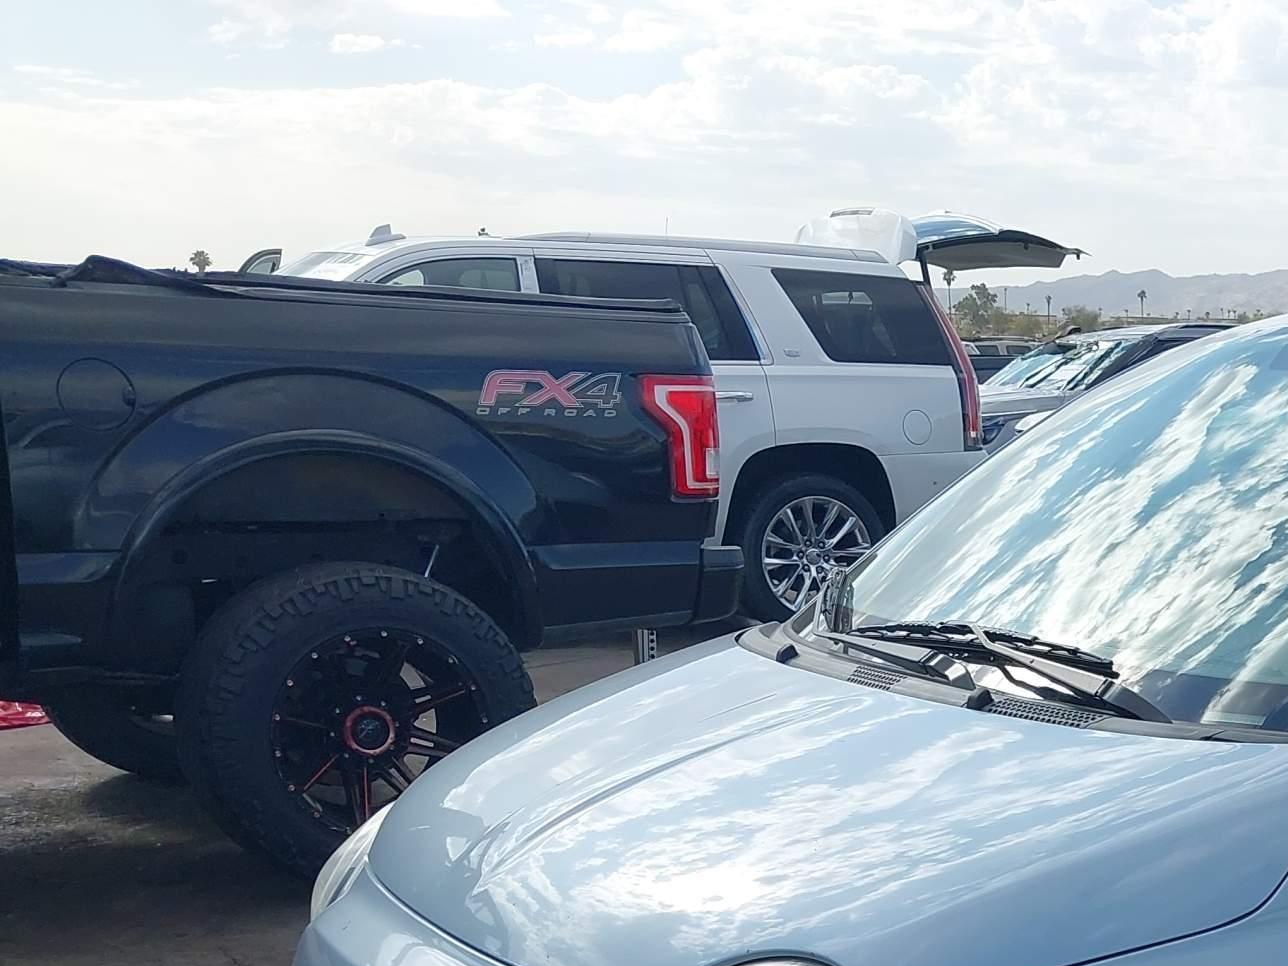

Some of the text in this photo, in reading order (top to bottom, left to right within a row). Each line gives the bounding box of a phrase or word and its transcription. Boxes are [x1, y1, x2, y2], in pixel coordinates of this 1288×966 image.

[478, 369, 622, 408] FX4
[476, 407, 616, 417] OFF ROAD
